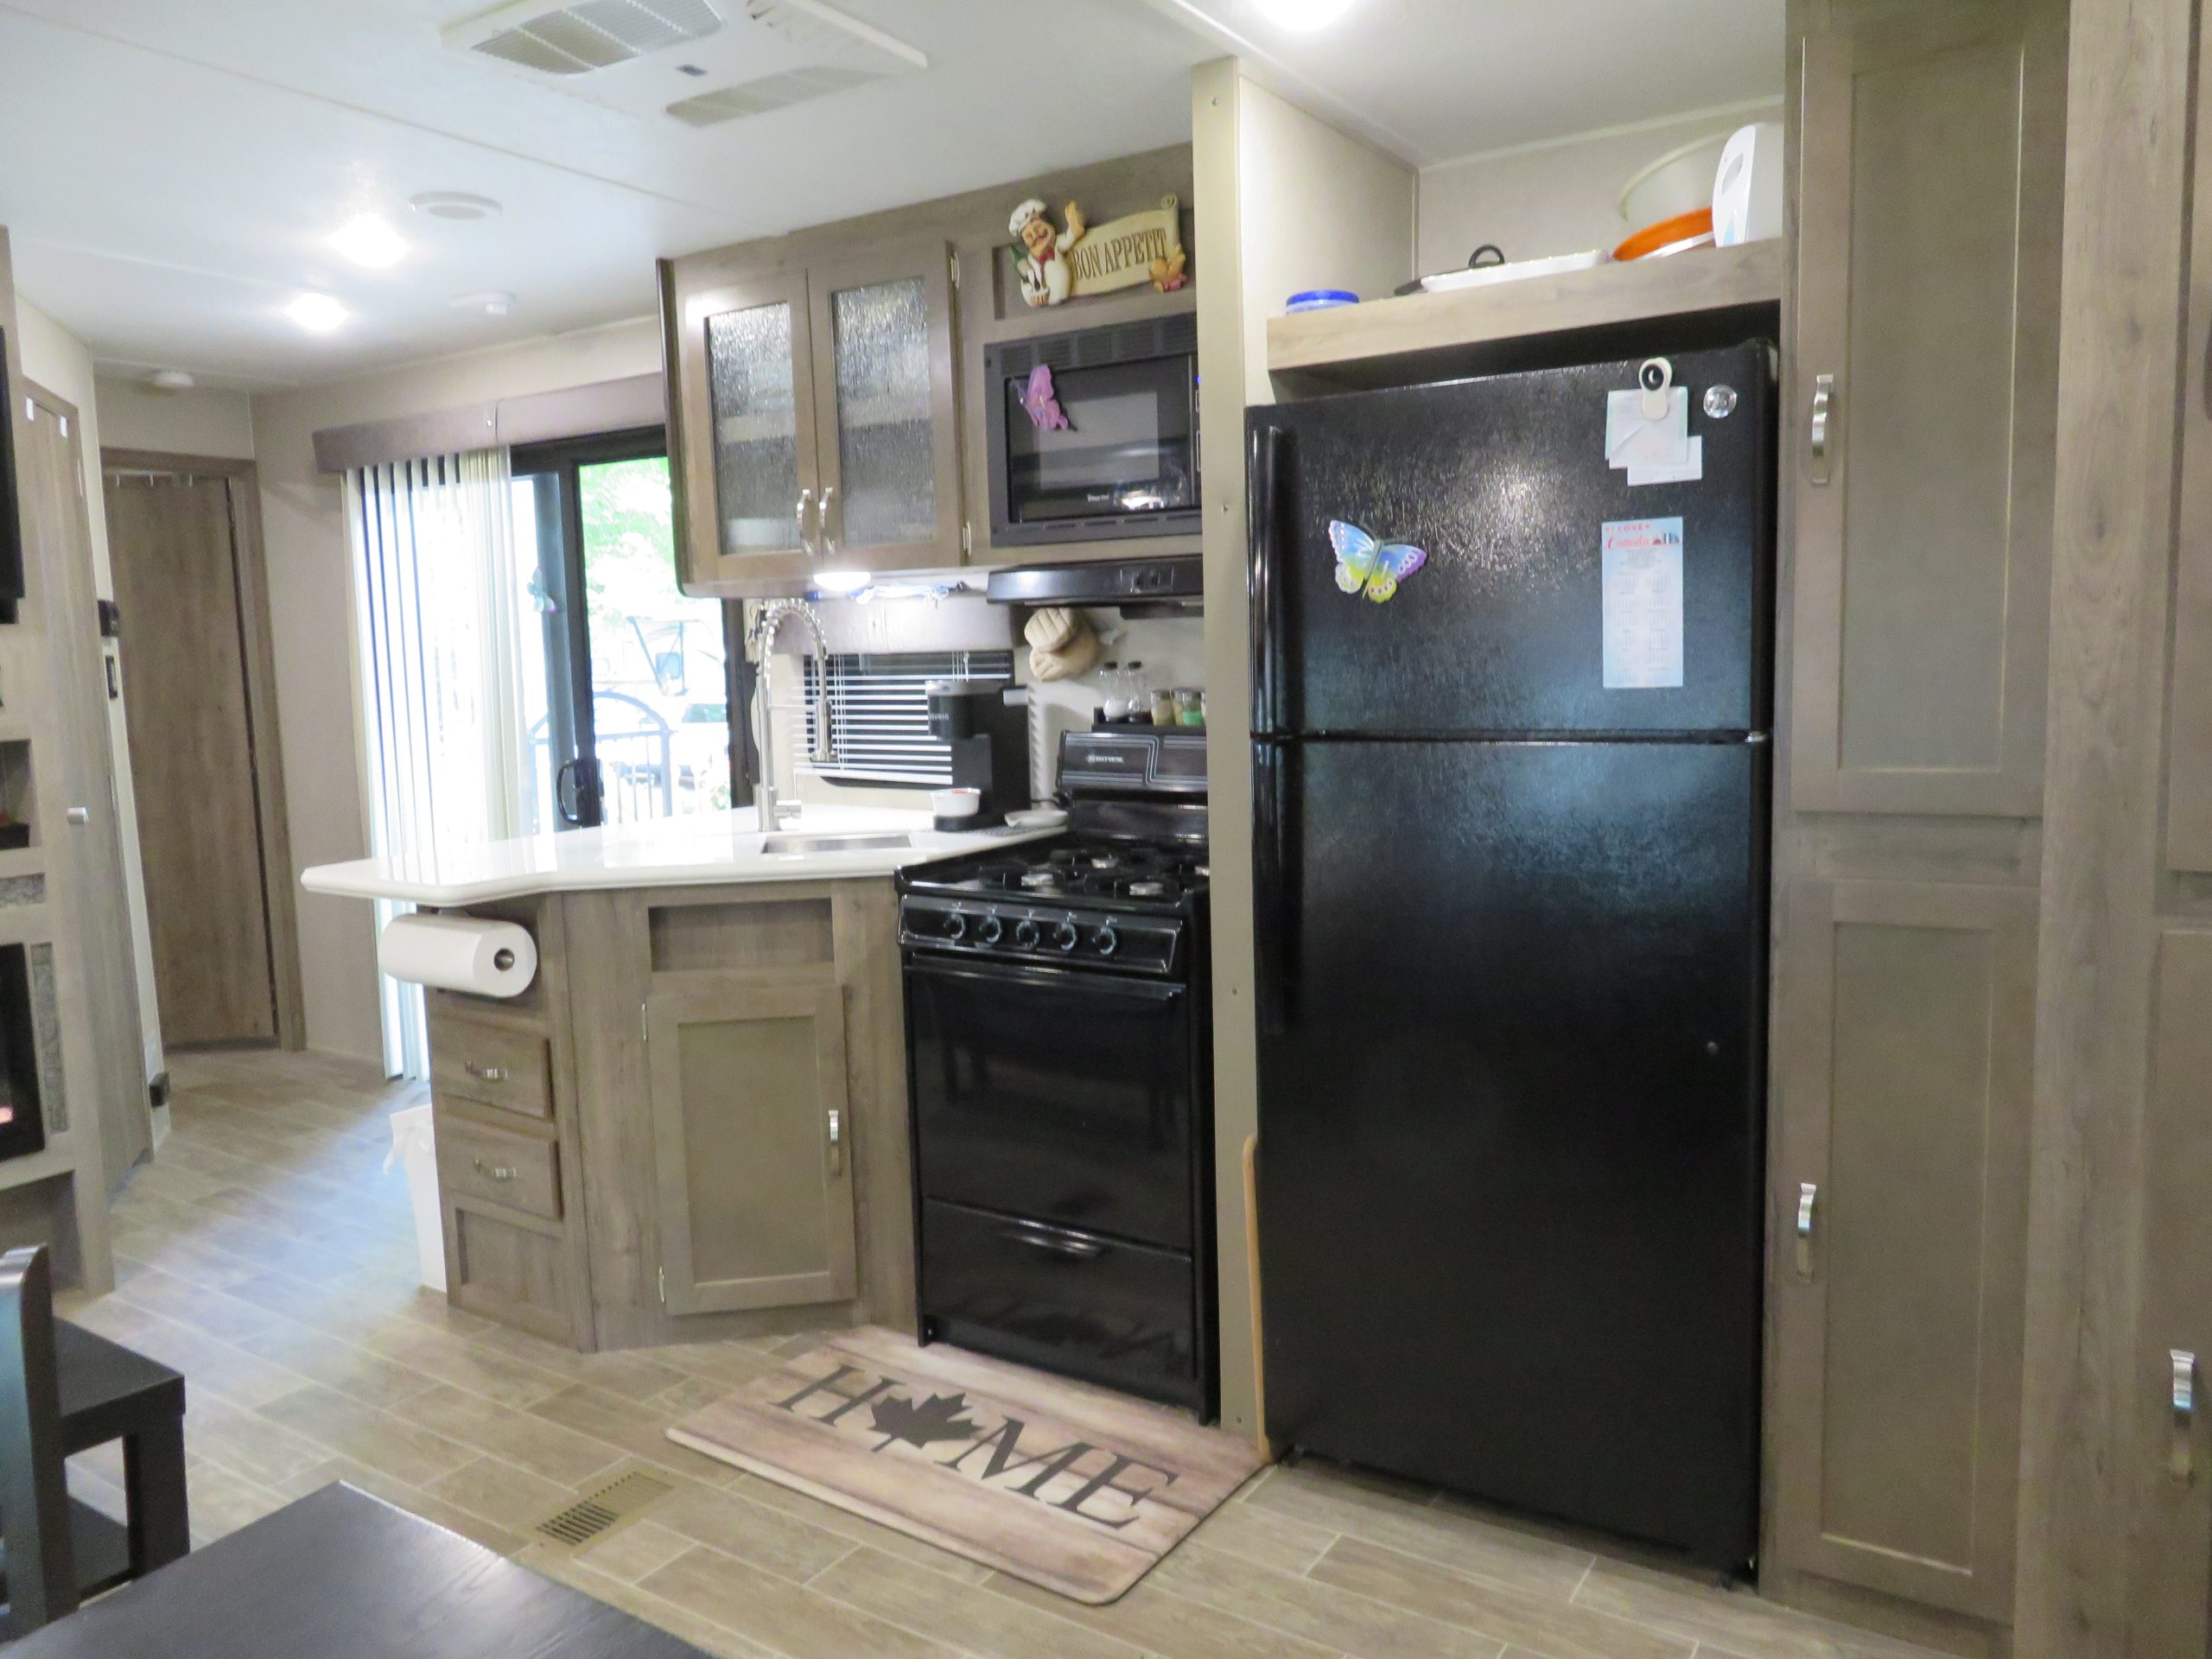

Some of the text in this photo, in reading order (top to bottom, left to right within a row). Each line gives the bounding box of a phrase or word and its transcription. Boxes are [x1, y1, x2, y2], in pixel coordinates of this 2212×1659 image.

[1072, 227, 1166, 280] BON APPETIT
[1618, 524, 1643, 532] LOVE
[768, 1364, 1179, 1530] HME
